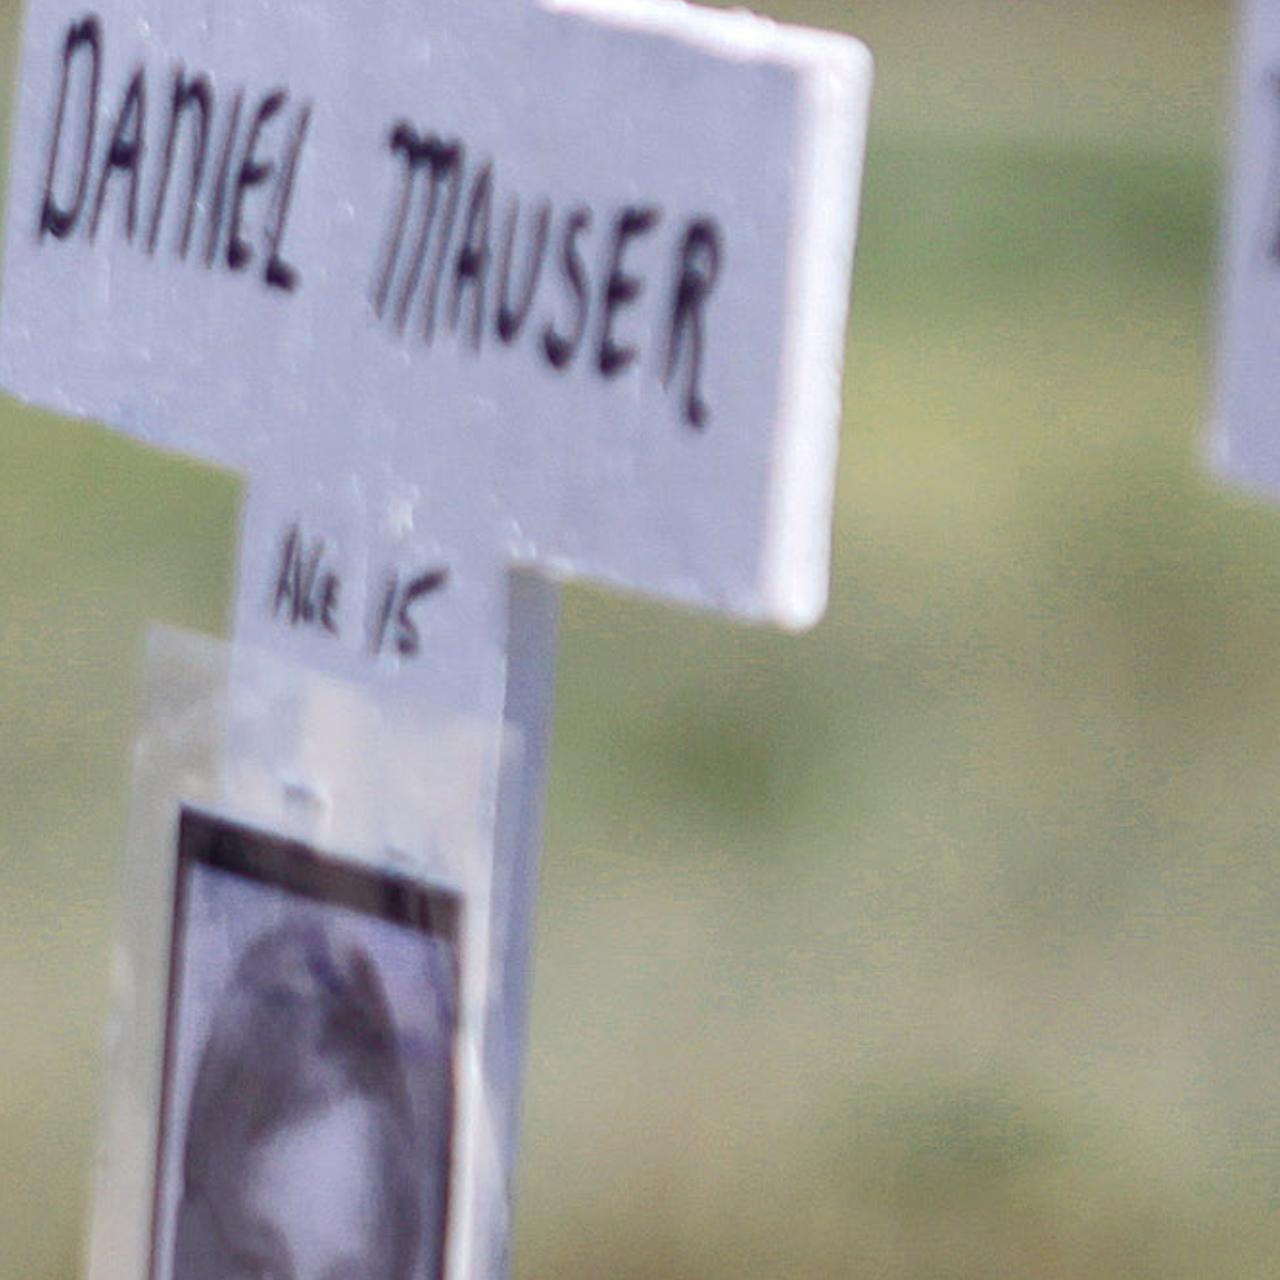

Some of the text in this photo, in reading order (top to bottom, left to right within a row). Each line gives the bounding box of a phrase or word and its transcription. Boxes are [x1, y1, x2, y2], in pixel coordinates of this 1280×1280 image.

[35, 13, 724, 431] DANIEL MAUSER
[365, 563, 449, 658] 15
